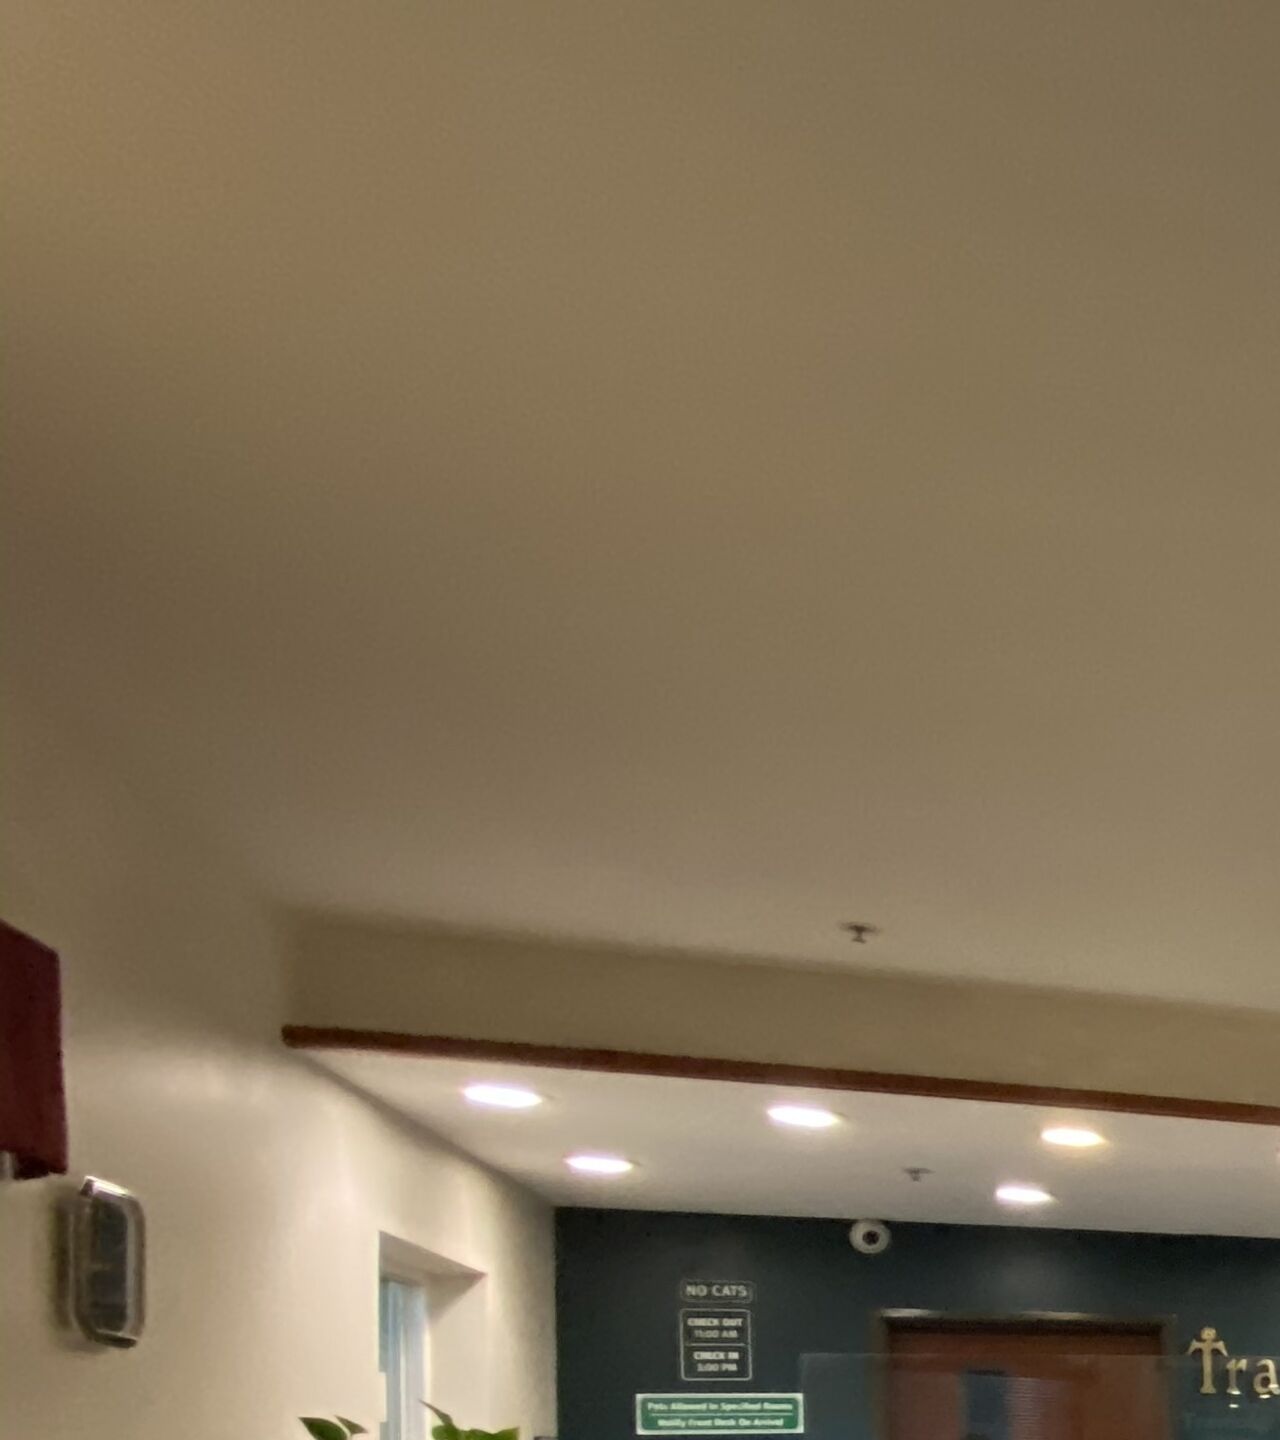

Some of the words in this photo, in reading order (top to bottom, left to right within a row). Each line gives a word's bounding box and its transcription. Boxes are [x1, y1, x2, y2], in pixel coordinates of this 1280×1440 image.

[686, 1285, 707, 1296] NO
[711, 1285, 747, 1297] CATS
[687, 1317, 720, 1327] CHECK
